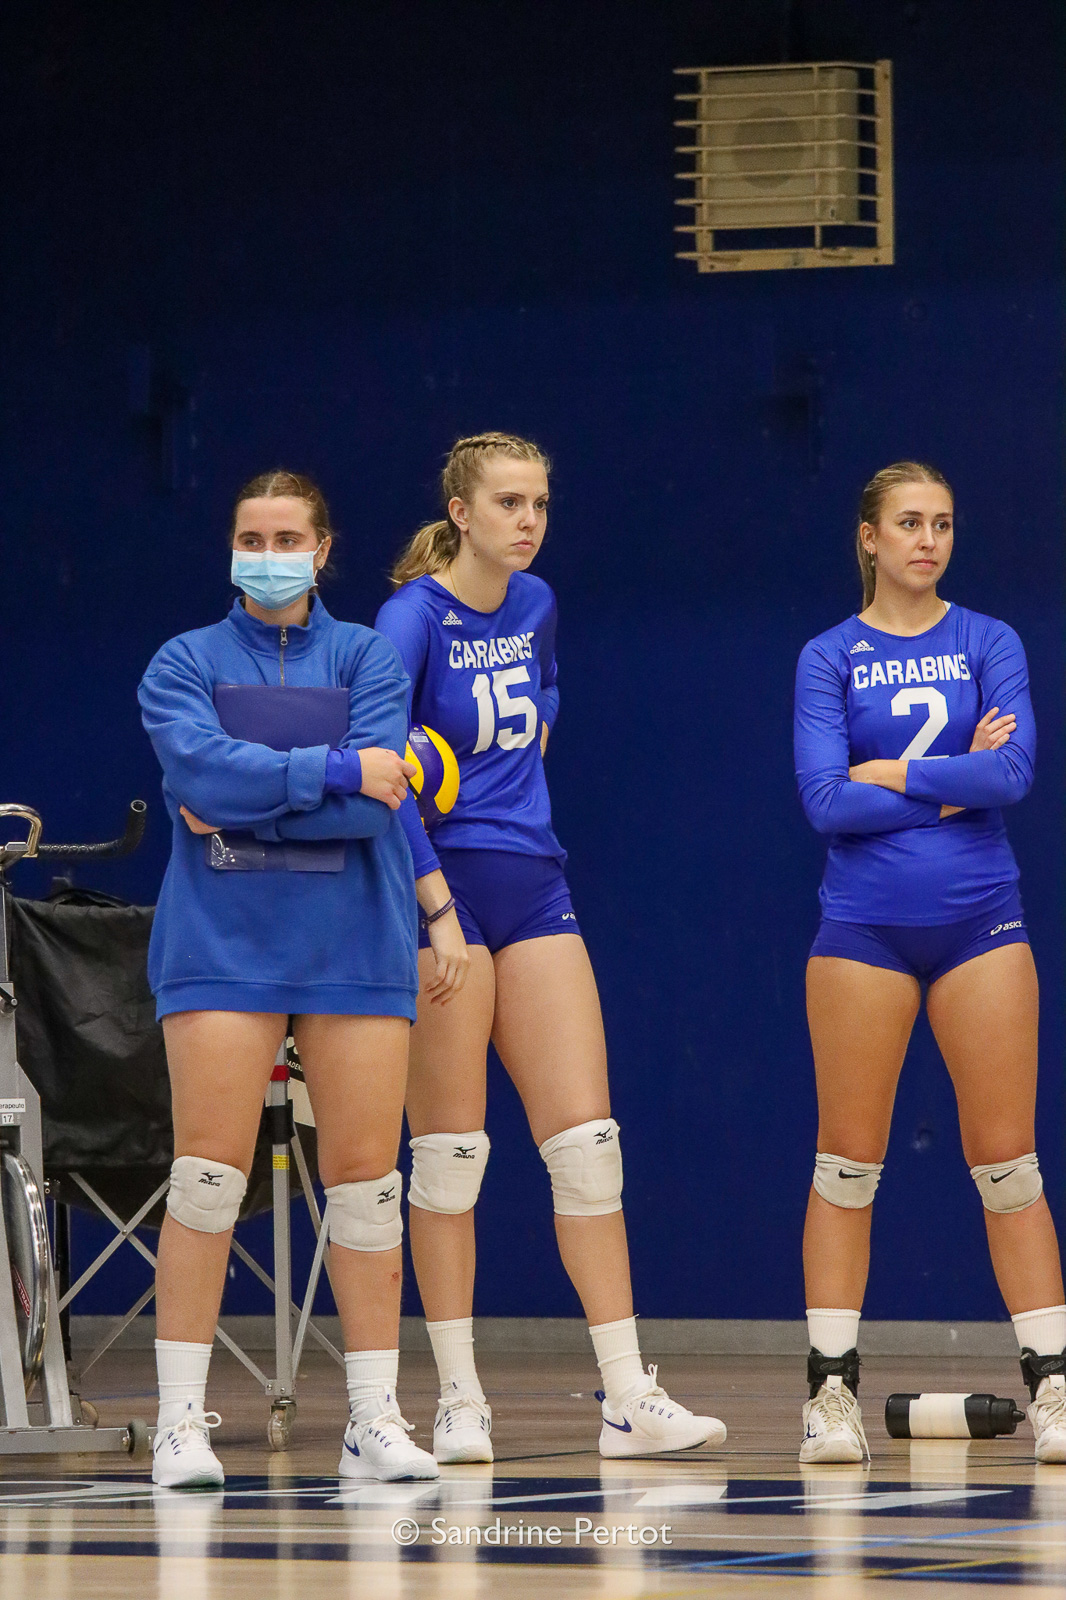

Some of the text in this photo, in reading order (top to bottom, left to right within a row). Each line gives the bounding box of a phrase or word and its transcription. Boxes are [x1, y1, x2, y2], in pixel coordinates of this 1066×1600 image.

[448, 631, 535, 669] CARABINS
[849, 646, 875, 655] adidas
[853, 653, 971, 690] CARABINS
[472, 665, 538, 755] 15
[890, 686, 950, 761] 2
[3, 1114, 13, 1123] 17
